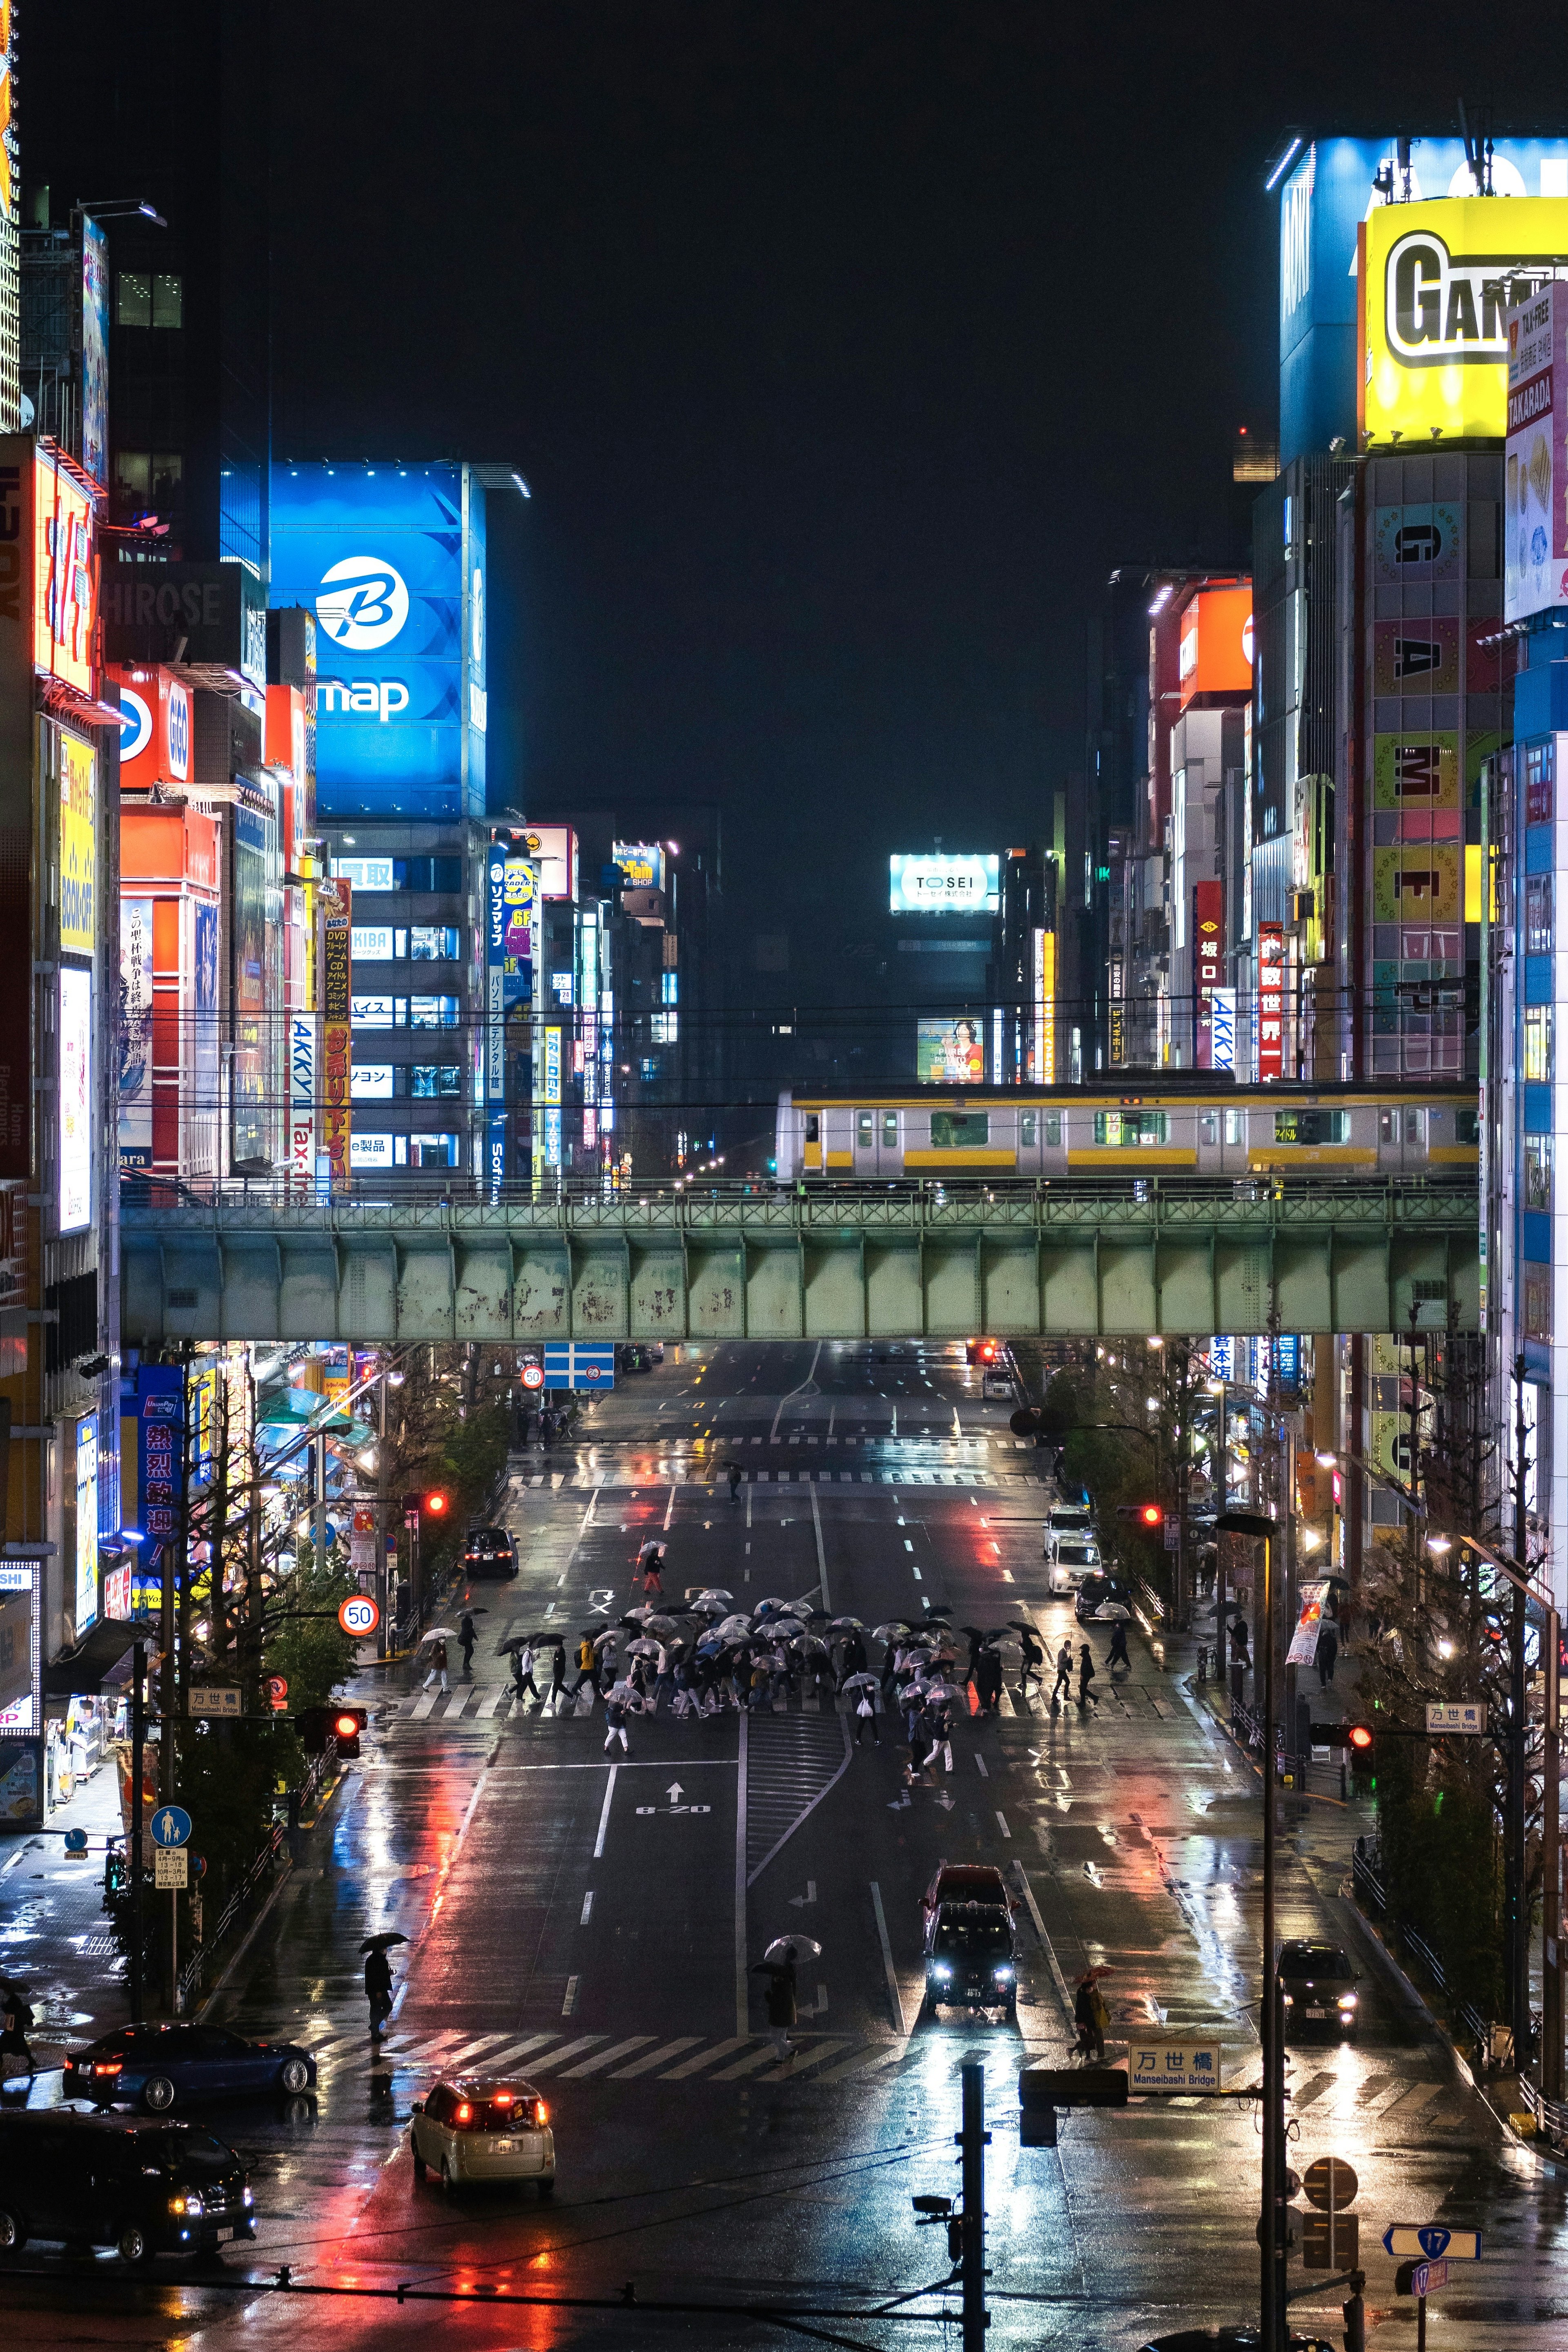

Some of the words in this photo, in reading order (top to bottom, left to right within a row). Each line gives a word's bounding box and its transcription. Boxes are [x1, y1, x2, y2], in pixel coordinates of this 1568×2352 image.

[1523, 298, 1549, 338] TAX-FREE
[1508, 376, 1551, 429] TAKARADA
[100, 582, 221, 626] HIROSE
[492, 885, 503, 947] ソフマップ
[513, 910, 531, 926] 6F
[327, 919, 347, 928] あなたの
[328, 932, 346, 940] DVD
[354, 933, 386, 947] KIBA
[330, 962, 344, 970] CD
[327, 972, 347, 980] アイドル
[328, 1002, 345, 1010] ホビー
[294, 1019, 312, 1095] AKKY
[547, 1032, 558, 1099] TRADER
[11, 1104, 24, 1146] Home
[1275, 1128, 1296, 1141] アイドル
[527, 1372, 539, 1382] 50
[147, 1401, 174, 1409] UnionPay
[1169, 1515, 1179, 1529] P
[348, 1607, 370, 1624] 50
[193, 1693, 236, 1705] 万世橋
[1431, 1708, 1476, 1721] 万世橋
[1462, 1722, 1478, 1731] Bridge
[1137, 2051, 1213, 2071] 万世橋
[1134, 2074, 1185, 2084] Manseibashi
[1188, 2074, 1215, 2087] Bridge
[1425, 2232, 1445, 2250] 17
[1420, 2267, 1428, 2288] 17
